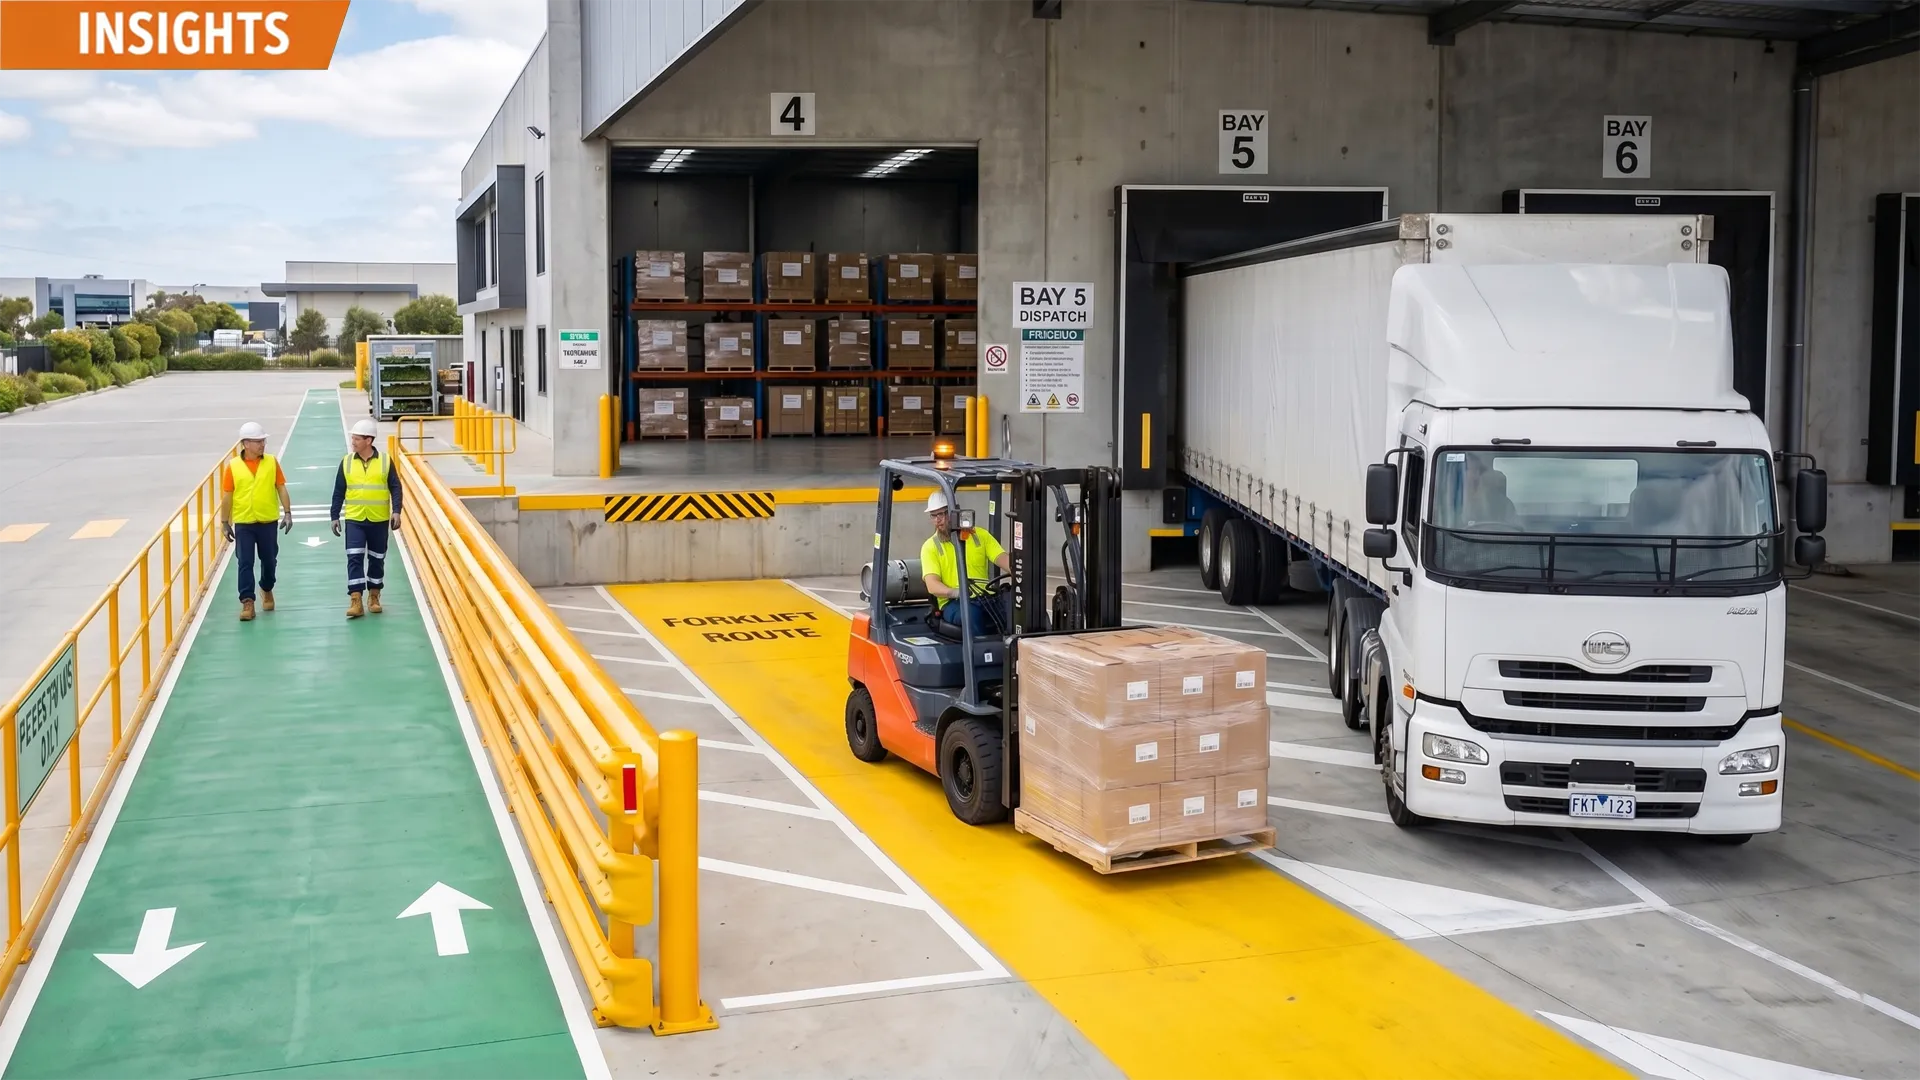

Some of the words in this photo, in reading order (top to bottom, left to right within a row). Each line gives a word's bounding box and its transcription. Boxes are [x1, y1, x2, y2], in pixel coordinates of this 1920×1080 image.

[780, 96, 805, 131] 4
[1222, 114, 1265, 131] BAY
[1607, 120, 1648, 137] BAY
[1231, 136, 1255, 169] 5
[1616, 141, 1638, 174] 6
[1020, 287, 1066, 306] BAY
[1074, 288, 1086, 306] 5
[1020, 310, 1087, 322] DISPATCH
[662, 611, 819, 628] FORKLIFT
[702, 627, 822, 643] ROUTE
[1572, 797, 1598, 812] FKT
[1609, 799, 1633, 814] 123
